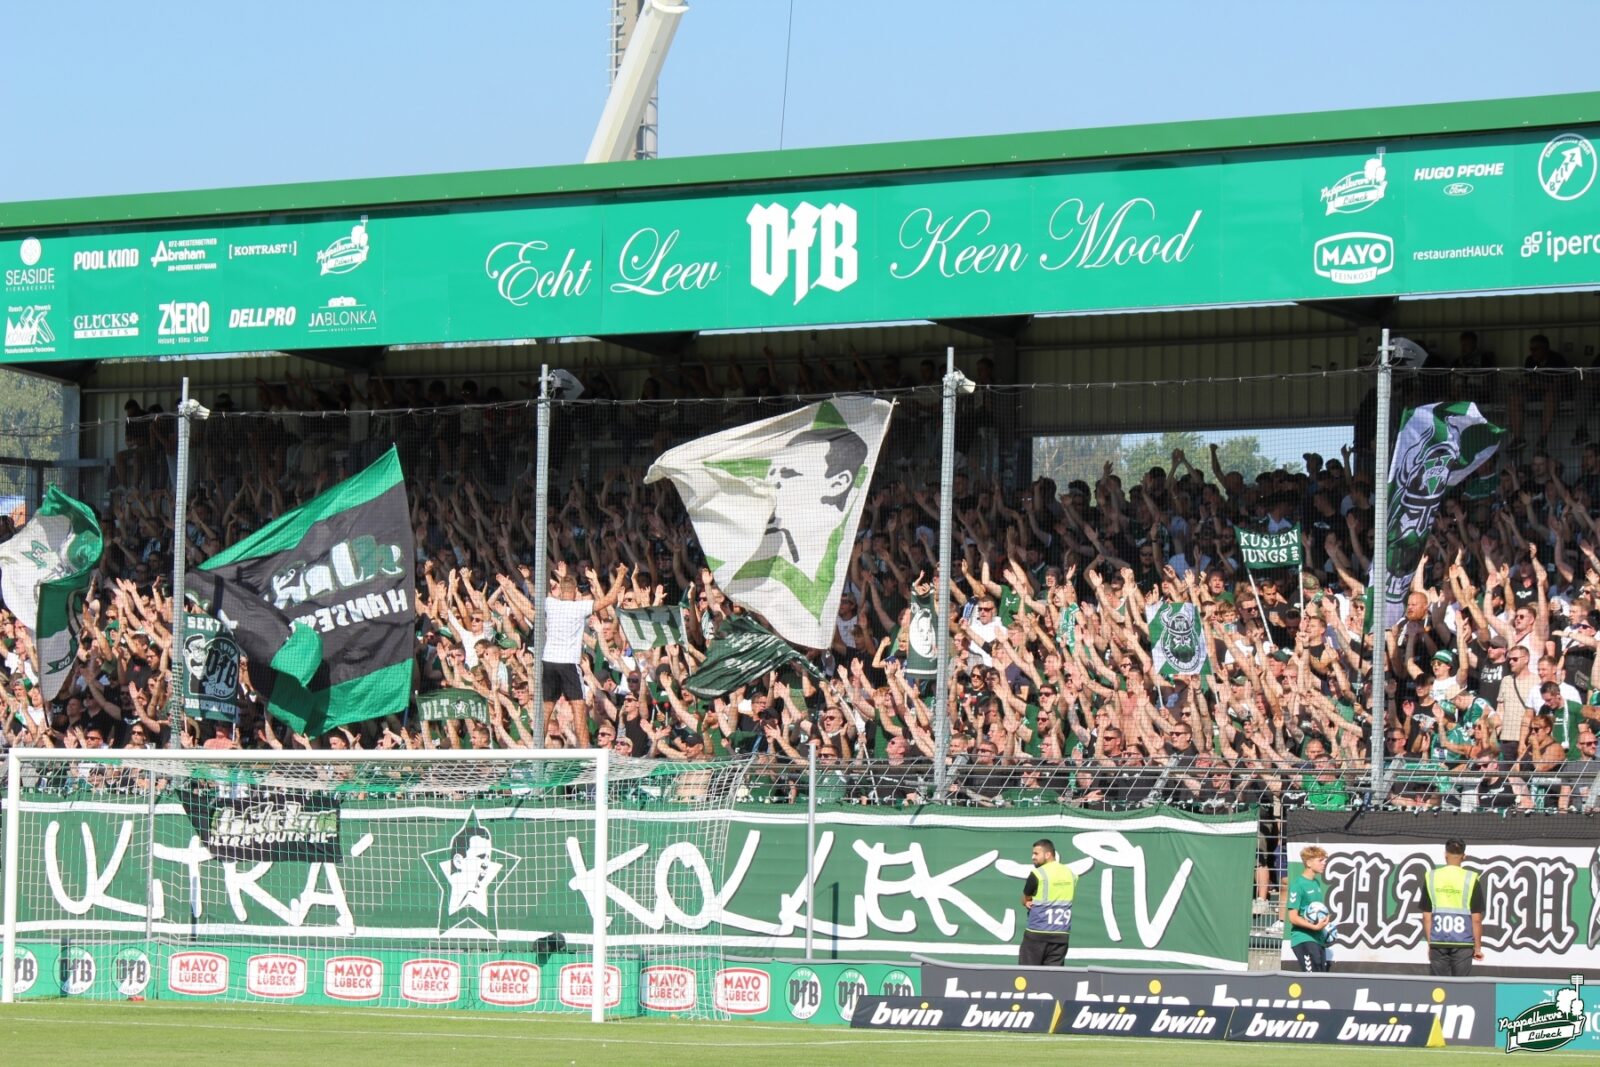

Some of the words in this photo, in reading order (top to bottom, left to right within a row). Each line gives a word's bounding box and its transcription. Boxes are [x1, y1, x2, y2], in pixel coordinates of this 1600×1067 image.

[1414, 166, 1455, 181] HUGO
[1457, 162, 1505, 178] PFOHE
[151, 240, 206, 267] Abraham
[485, 240, 592, 306] Echt
[610, 227, 721, 296] Leev
[889, 207, 1028, 279] Keen
[1039, 197, 1203, 270] Mood
[1322, 243, 1387, 266] MAYO
[1413, 244, 1504, 260] restaurantHAUCK
[6, 267, 55, 286] SEASIDE
[1334, 271, 1373, 281] FEINKOST
[229, 306, 296, 328] DELLPRO
[308, 310, 377, 327] JABLONKA
[1242, 548, 1288, 563] JUNGS
[1045, 908, 1072, 926] 129
[1434, 914, 1465, 933] 308
[179, 959, 219, 973] MAYO
[257, 960, 297, 975] MAYO
[334, 964, 373, 978] MAYO
[412, 966, 450, 980] MAYO
[178, 972, 217, 983] LÜBECK
[257, 974, 297, 986] LÜBECK
[490, 967, 530, 982] MAYO
[649, 974, 687, 988] MAYO
[334, 977, 372, 988] LÜBECK
[411, 979, 449, 991] LÜBECK
[489, 981, 529, 993] LÜBECK
[724, 976, 761, 990] MAYO
[649, 987, 686, 999] LÜBECK
[725, 989, 760, 1002] LÜBECK
[870, 1002, 943, 1026] bwin
[962, 1003, 1035, 1028] bwin
[1072, 1006, 1137, 1031] bwin
[1151, 1009, 1216, 1034] bwin
[1246, 1012, 1311, 1038] bwin
[1337, 1016, 1412, 1042] bwin
